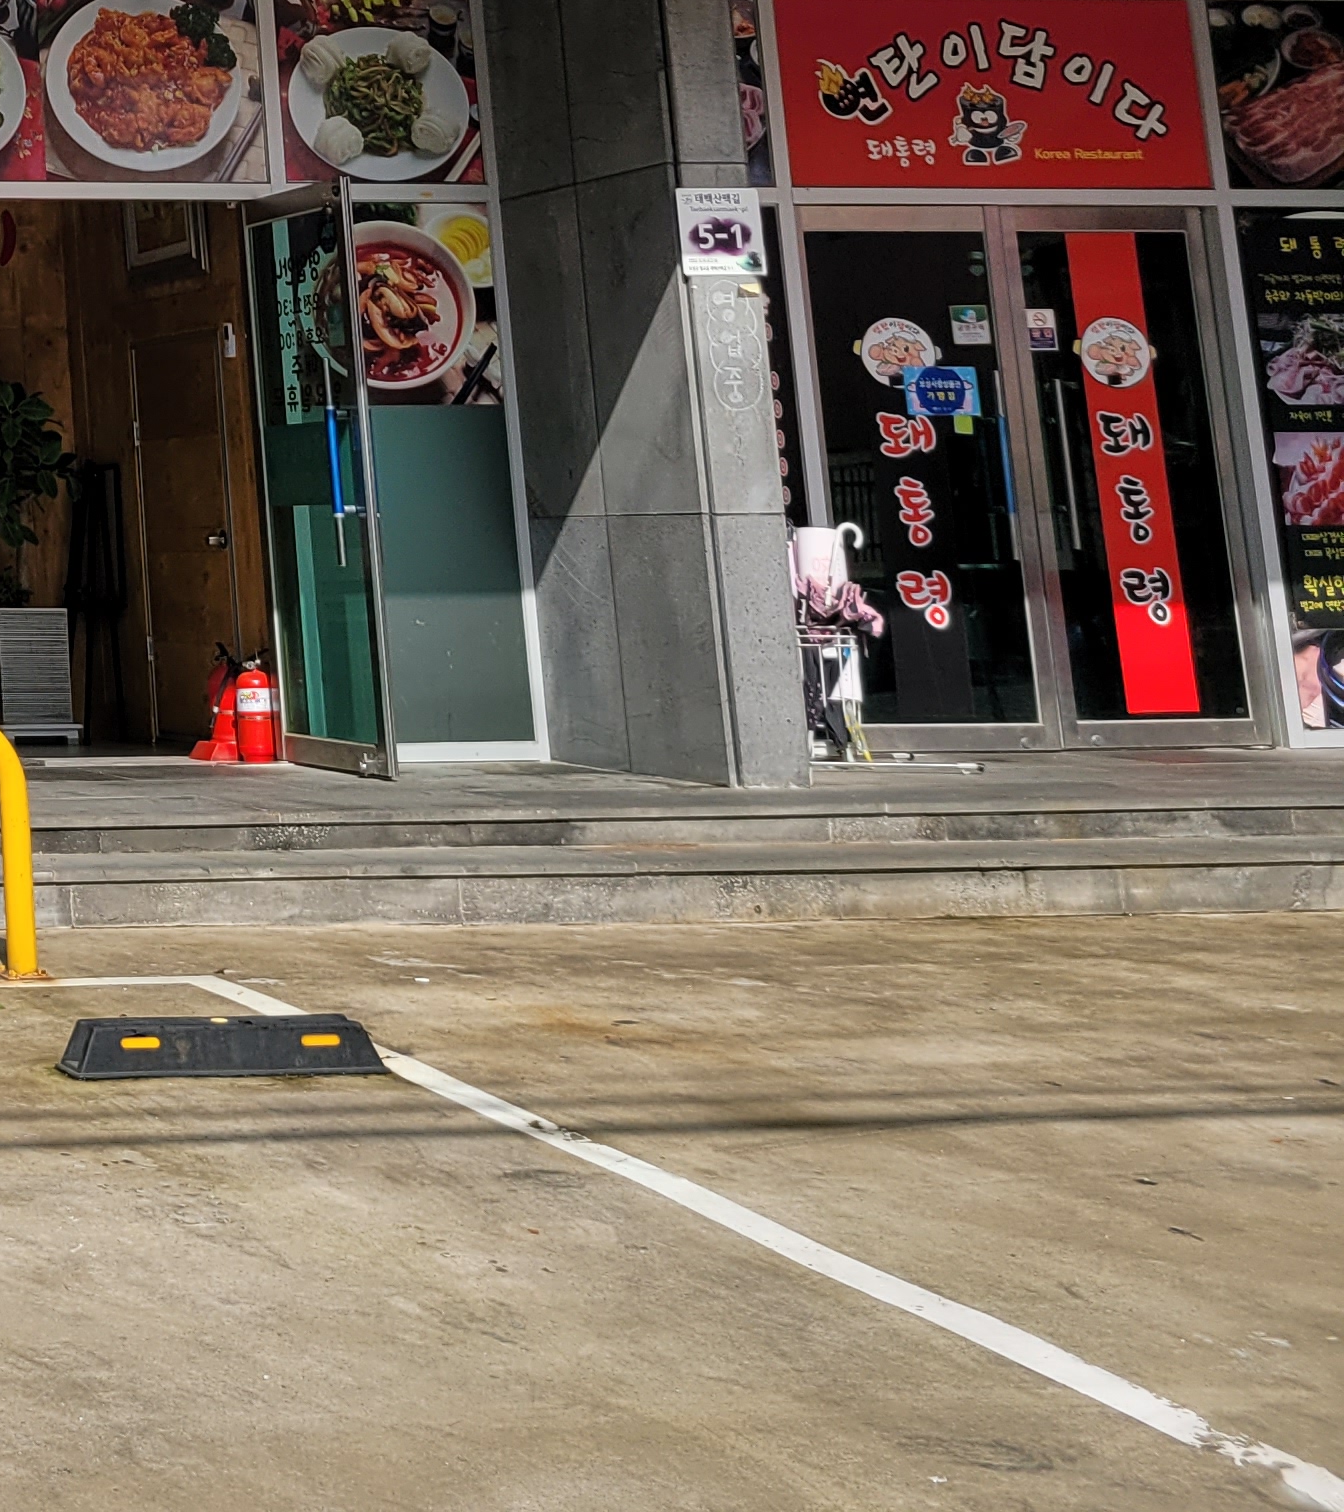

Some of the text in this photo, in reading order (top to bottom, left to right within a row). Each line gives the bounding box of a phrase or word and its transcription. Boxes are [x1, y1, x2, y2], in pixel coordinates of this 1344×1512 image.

[865, 135, 937, 168] 돼통령
[1034, 147, 1144, 160] Korea Restaurant
[697, 223, 744, 249] 5-1
